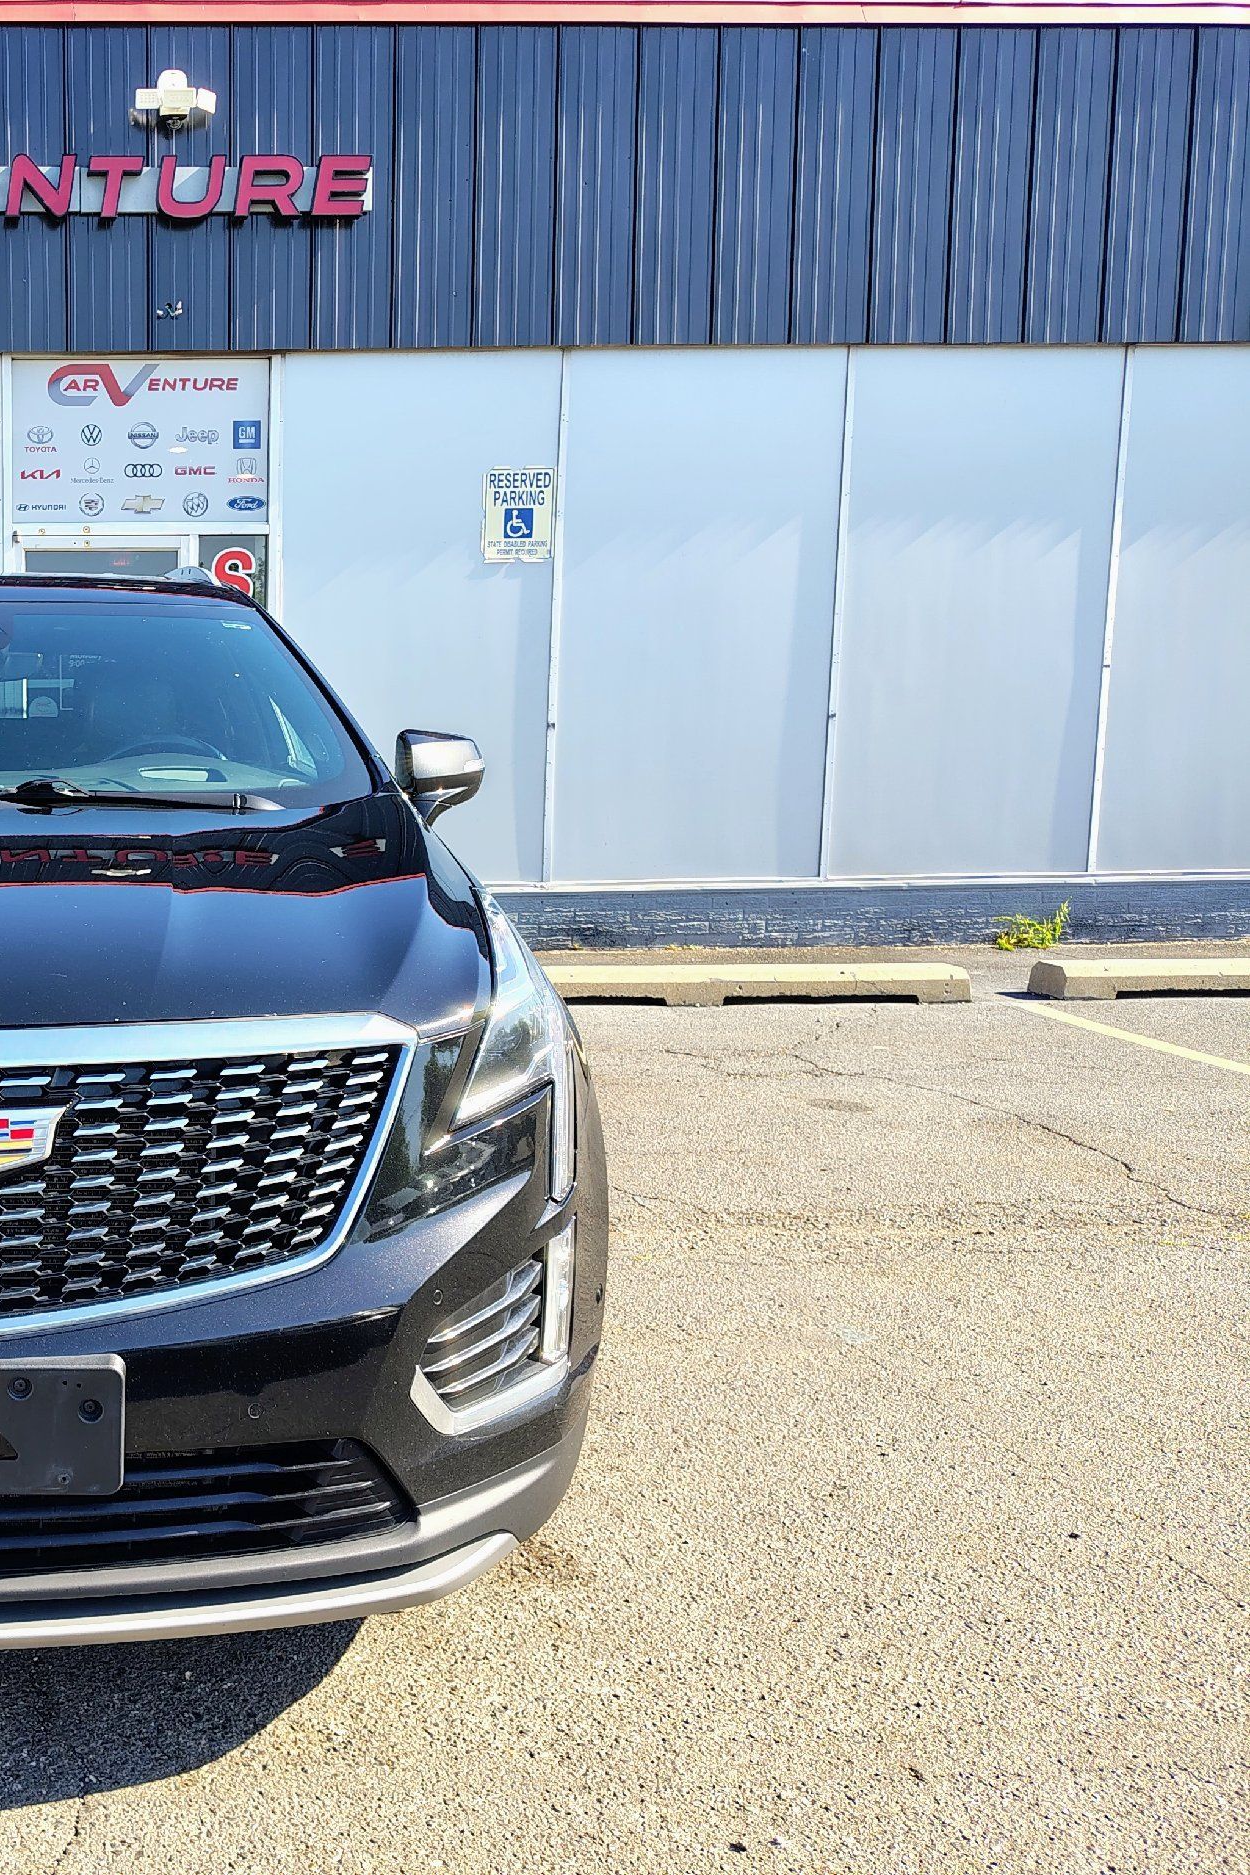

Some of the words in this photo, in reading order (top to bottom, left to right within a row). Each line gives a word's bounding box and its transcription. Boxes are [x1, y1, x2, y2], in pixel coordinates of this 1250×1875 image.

[174, 426, 220, 445] Jeep
[238, 426, 256, 440] GM
[20, 469, 61, 480] KIA
[174, 465, 216, 476] GMC
[489, 472, 551, 489] RESERVED
[233, 499, 259, 509] Ford
[493, 490, 545, 507] PARKING
[487, 540, 502, 548] STATE
[503, 540, 527, 548] DISABLED
[527, 540, 548, 548] PARKING
[496, 548, 514, 556] PERMIT
